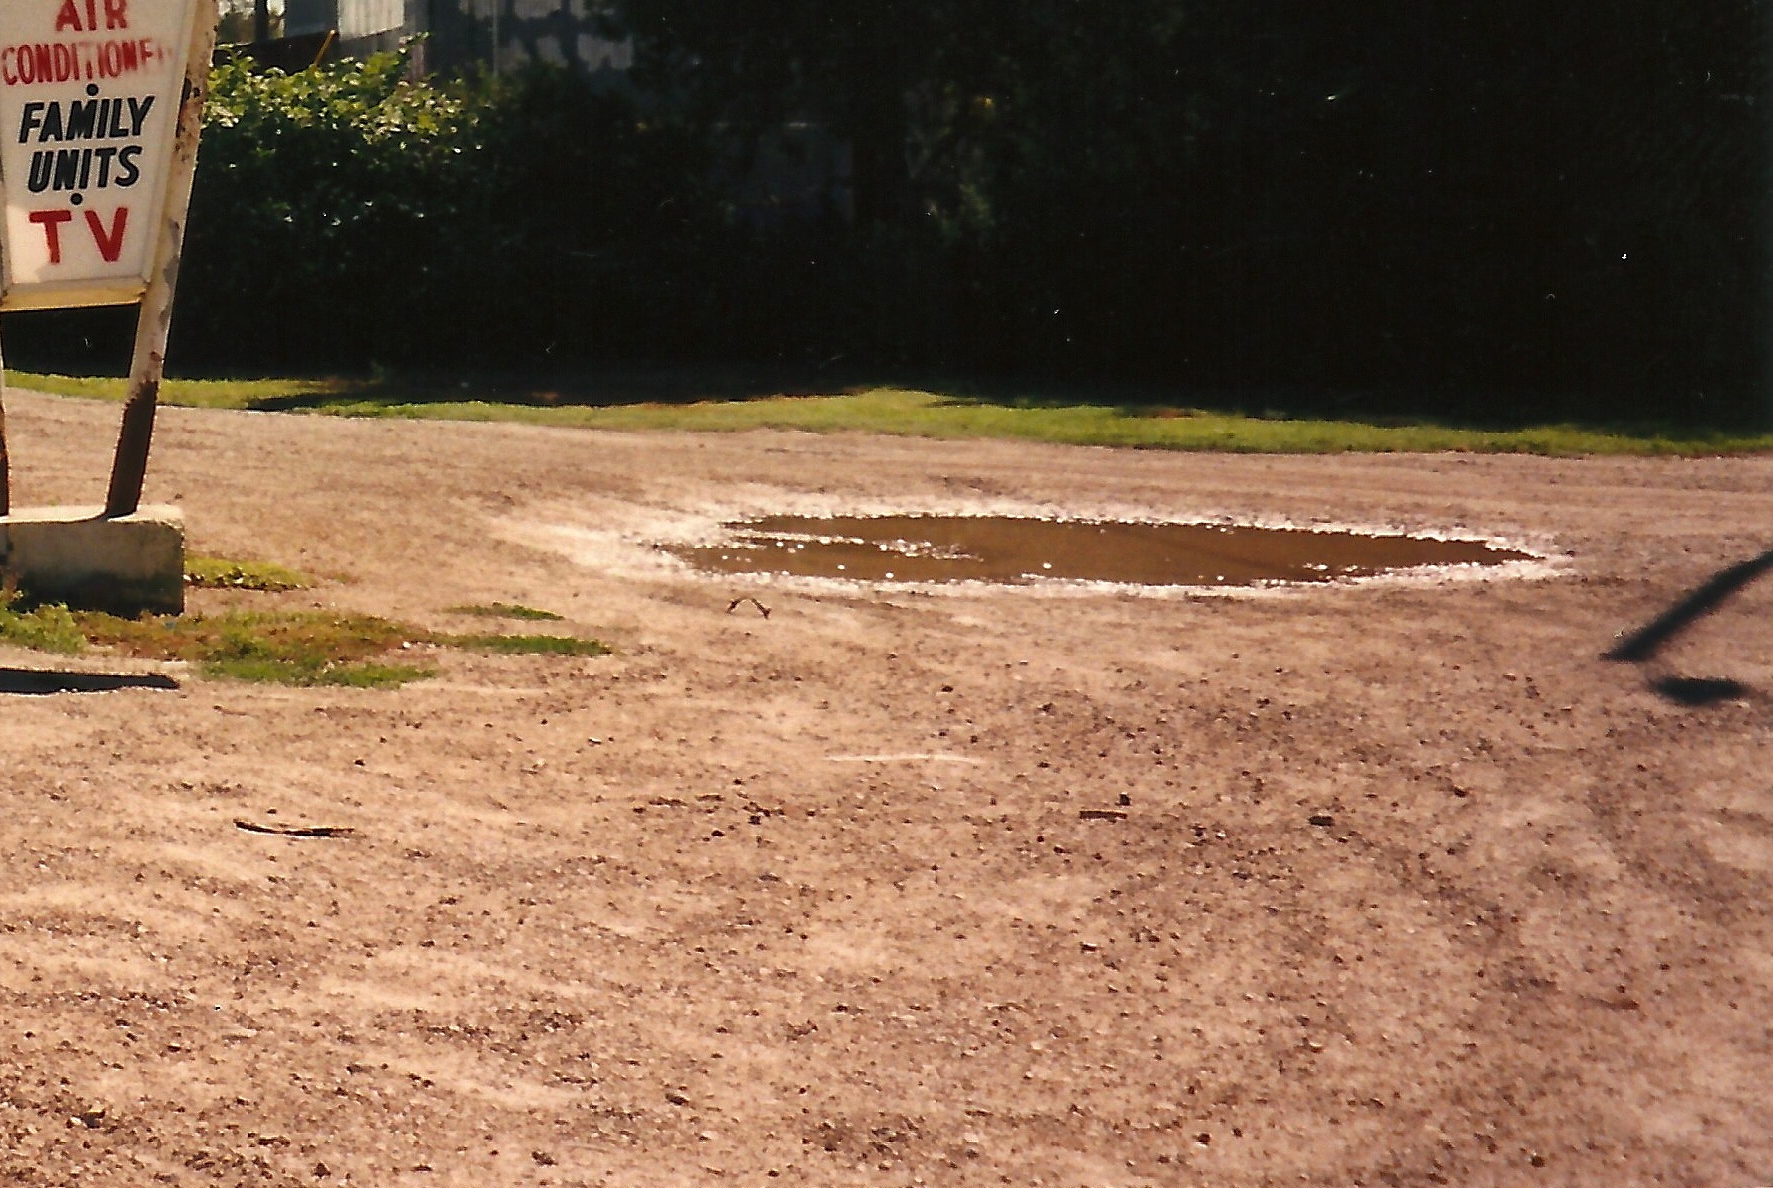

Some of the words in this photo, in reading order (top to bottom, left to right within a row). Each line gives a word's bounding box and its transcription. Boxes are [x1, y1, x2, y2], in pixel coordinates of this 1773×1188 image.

[18, 96, 155, 143] FAMILY
[27, 145, 143, 193] UNITS
[29, 207, 129, 265] TV
